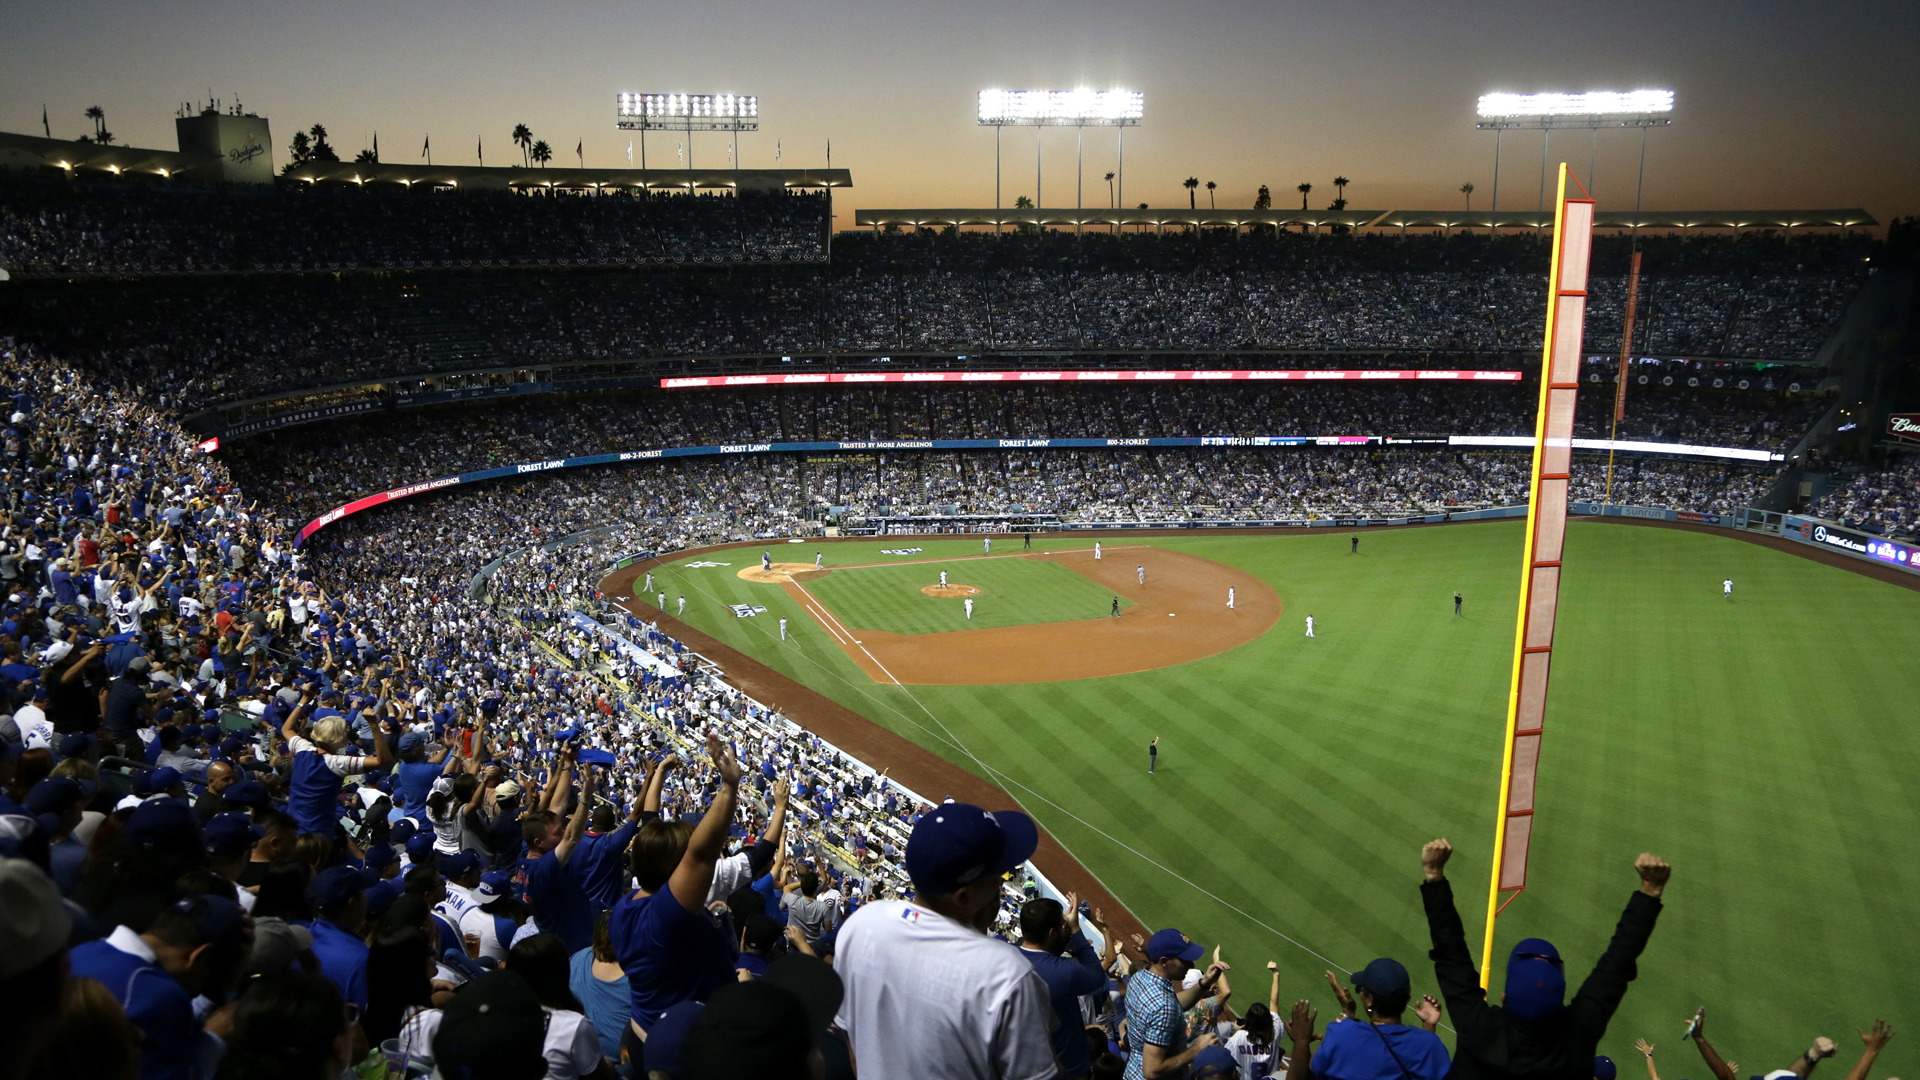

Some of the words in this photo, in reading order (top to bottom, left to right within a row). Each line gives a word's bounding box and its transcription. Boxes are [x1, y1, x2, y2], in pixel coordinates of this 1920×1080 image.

[230, 144, 264, 163] Dodgers
[224, 422, 260, 437] WELCOME
[265, 419, 276, 427] TO
[281, 411, 319, 424] DODGER
[325, 403, 371, 415] STADIUM
[896, 441, 933, 449] ANGELENOS
[999, 439, 1026, 447] FOREST
[1027, 439, 1049, 447] LAWN
[720, 445, 746, 454] FOREST
[748, 444, 770, 453] LAWN
[620, 450, 662, 460] 800-2-FOREST
[518, 462, 542, 473] FOREST
[544, 460, 563, 470] LAWN
[387, 489, 406, 499] TRUSTED
[415, 483, 428, 492] MORE
[429, 477, 460, 489] ANGELENOS
